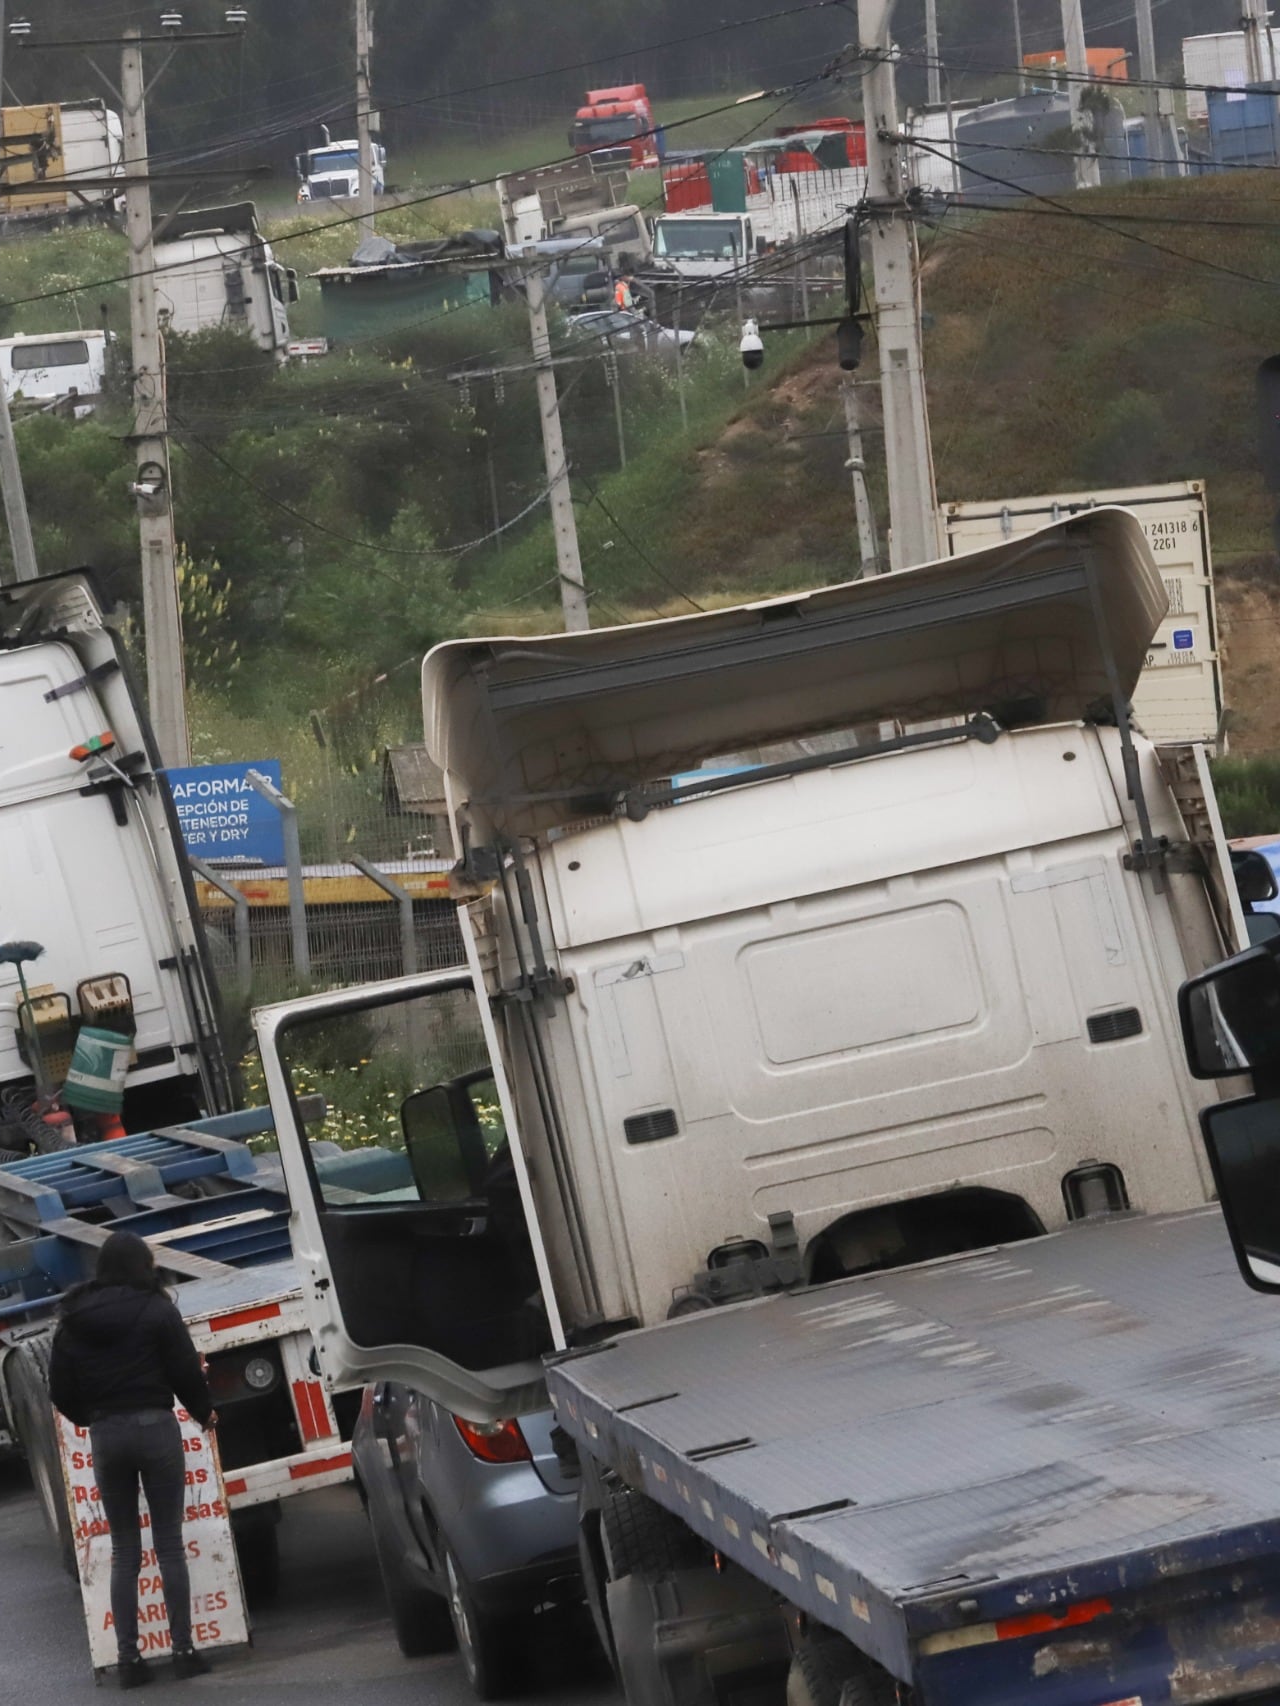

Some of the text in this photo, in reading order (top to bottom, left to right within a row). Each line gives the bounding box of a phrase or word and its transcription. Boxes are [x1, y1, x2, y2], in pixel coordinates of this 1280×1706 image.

[1151, 521, 1187, 535] 241318
[1192, 520, 1198, 532] 6
[1153, 537, 1176, 550] 22G1
[170, 778, 254, 799] AFORMA
[177, 799, 249, 817] EPCIÓN DE
[209, 830, 219, 842] Y
[221, 828, 249, 841] DRY
[139, 1575, 164, 1596] PA
